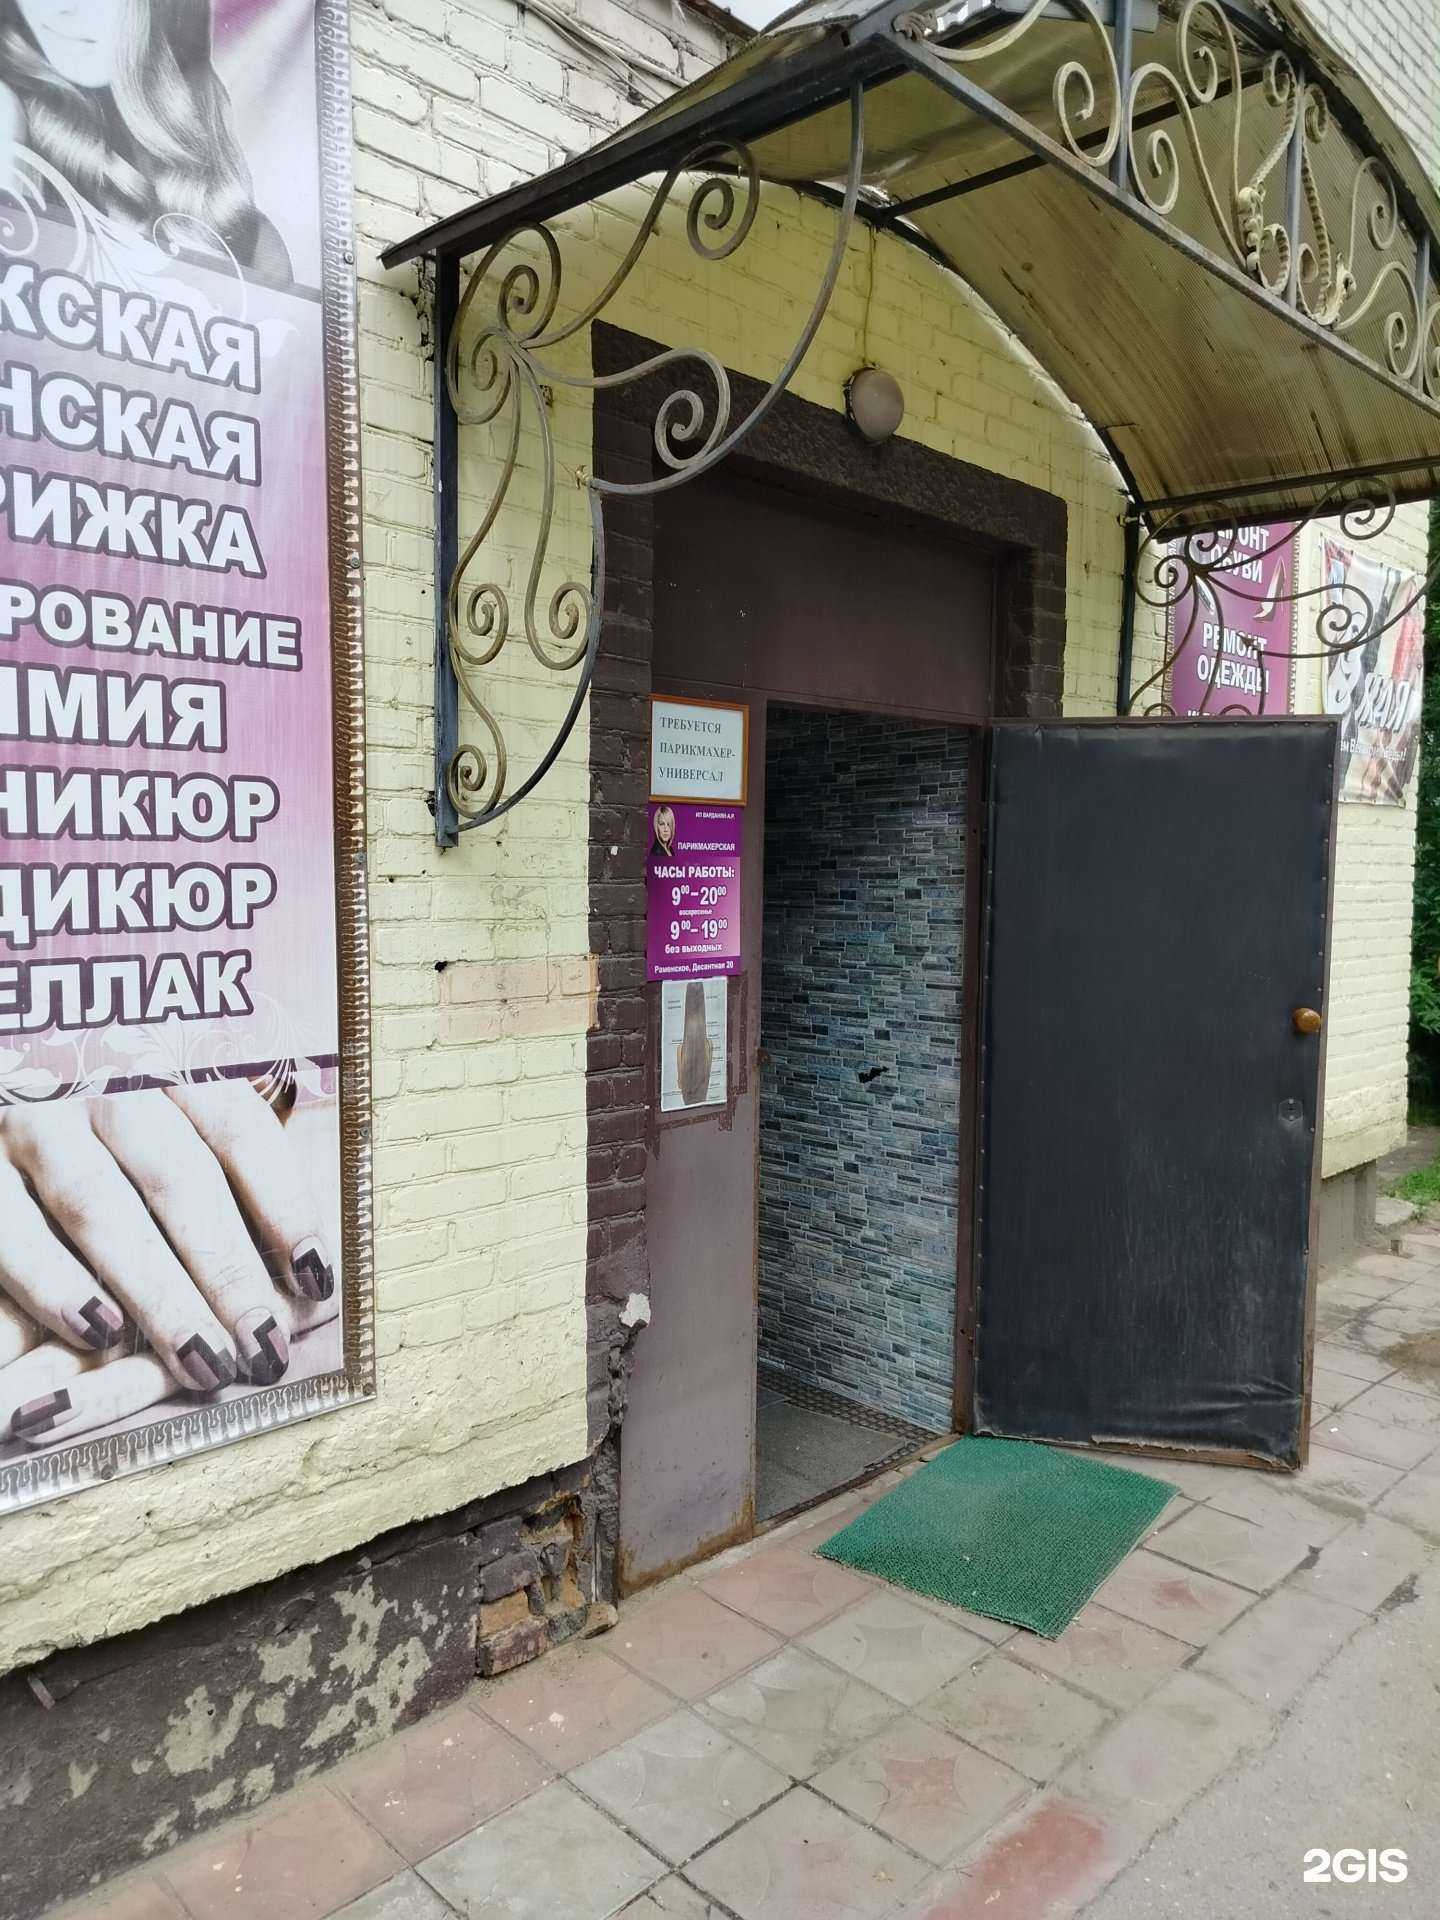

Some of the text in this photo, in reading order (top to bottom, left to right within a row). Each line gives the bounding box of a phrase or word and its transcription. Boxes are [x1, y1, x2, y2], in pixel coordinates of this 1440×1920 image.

[0, 467, 265, 577] ИЖКА
[0, 582, 301, 670] РОВАНИЕ
[1203, 622, 1267, 659] РЕМОНТ
[1197, 655, 1269, 695] ОДЕЖДЫ
[660, 717, 721, 734] ТРЕБУЕТСЯ
[660, 742, 736, 759] ПАРИКМАХЕР-
[658, 766, 724, 782] УНИВЕРСАЛ
[677, 842, 735, 851] ПАРИКМАХЕРСКАЯ
[654, 865, 735, 878] ЧАСЫ РАБОТЫ:
[665, 944, 722, 954] без выходных
